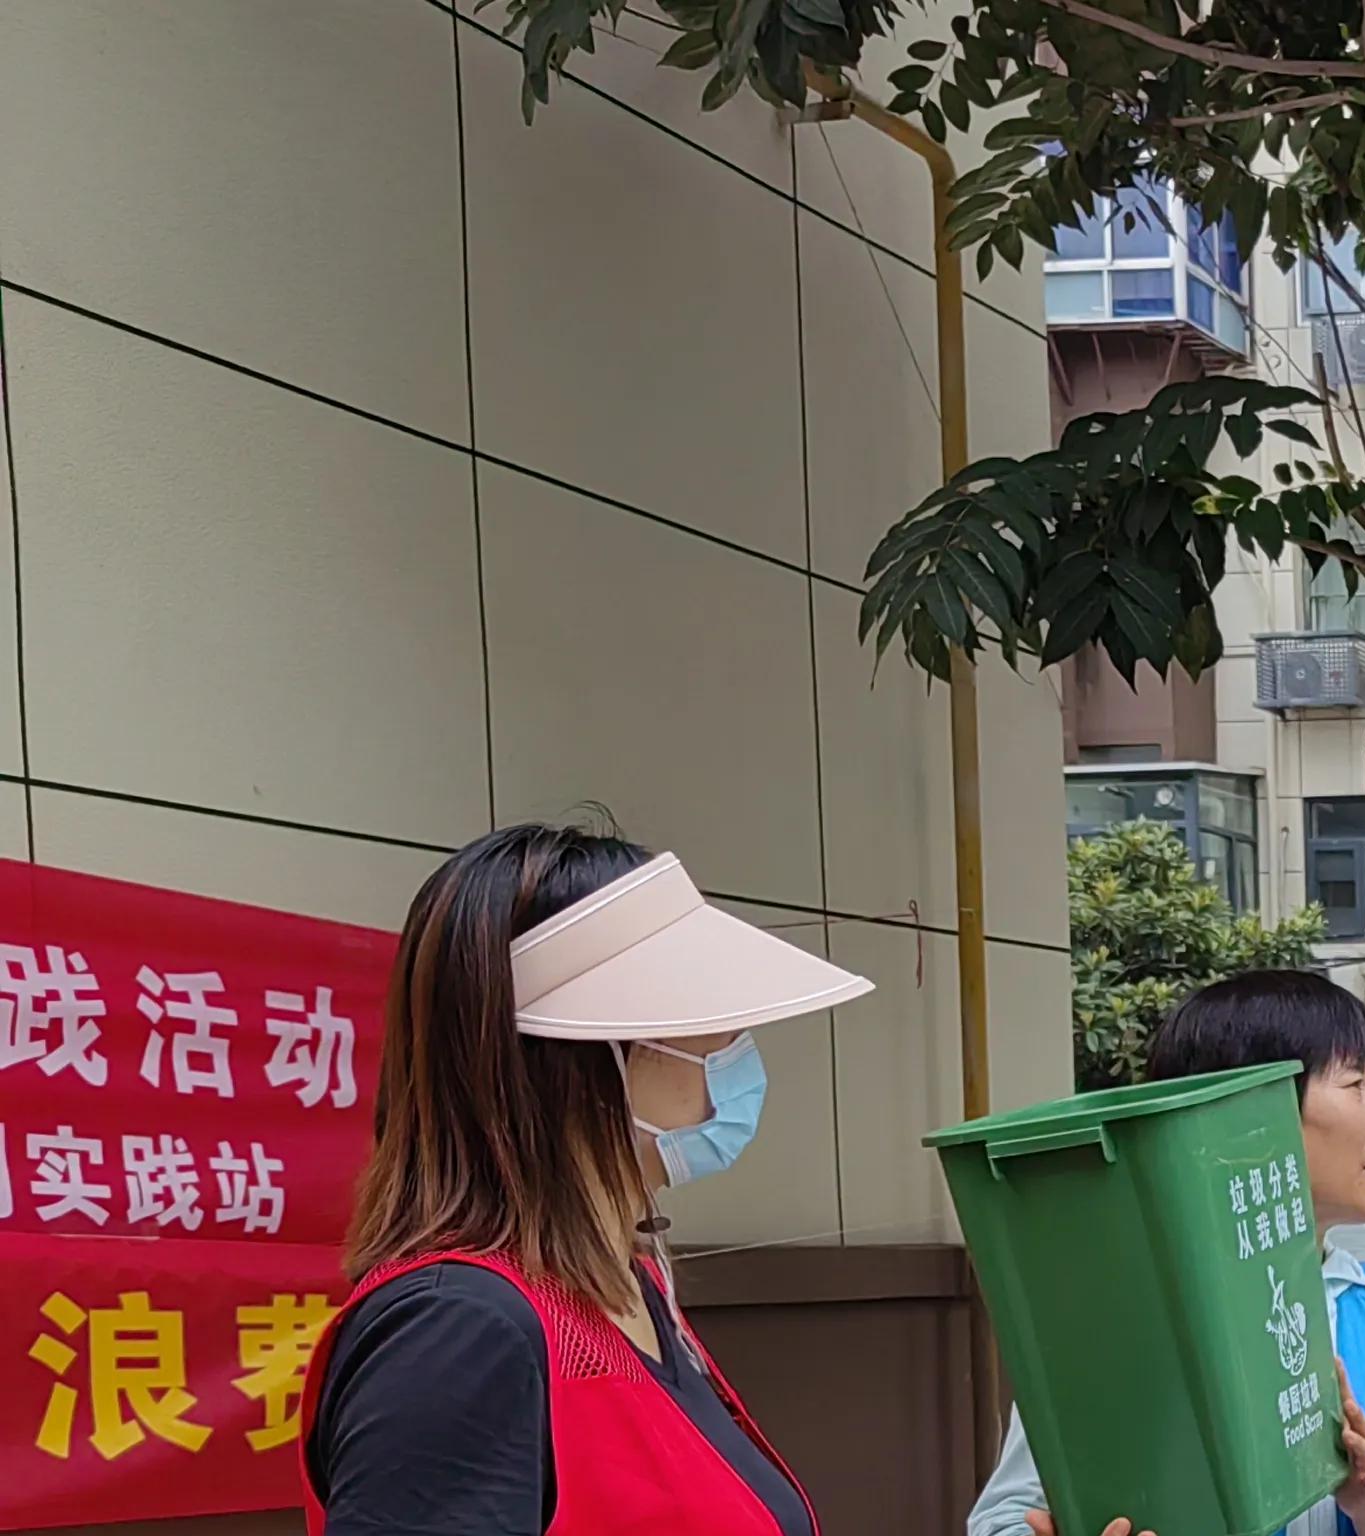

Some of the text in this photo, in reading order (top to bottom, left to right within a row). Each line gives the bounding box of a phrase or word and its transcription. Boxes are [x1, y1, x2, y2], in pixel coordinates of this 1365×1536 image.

[0, 943, 357, 1108] 践活动
[0, 1124, 285, 1234] 实践站
[1229, 1153, 1300, 1215] 垃圾分类
[1237, 1196, 1307, 1260] 从我做起
[1284, 1420, 1305, 1449] Food
